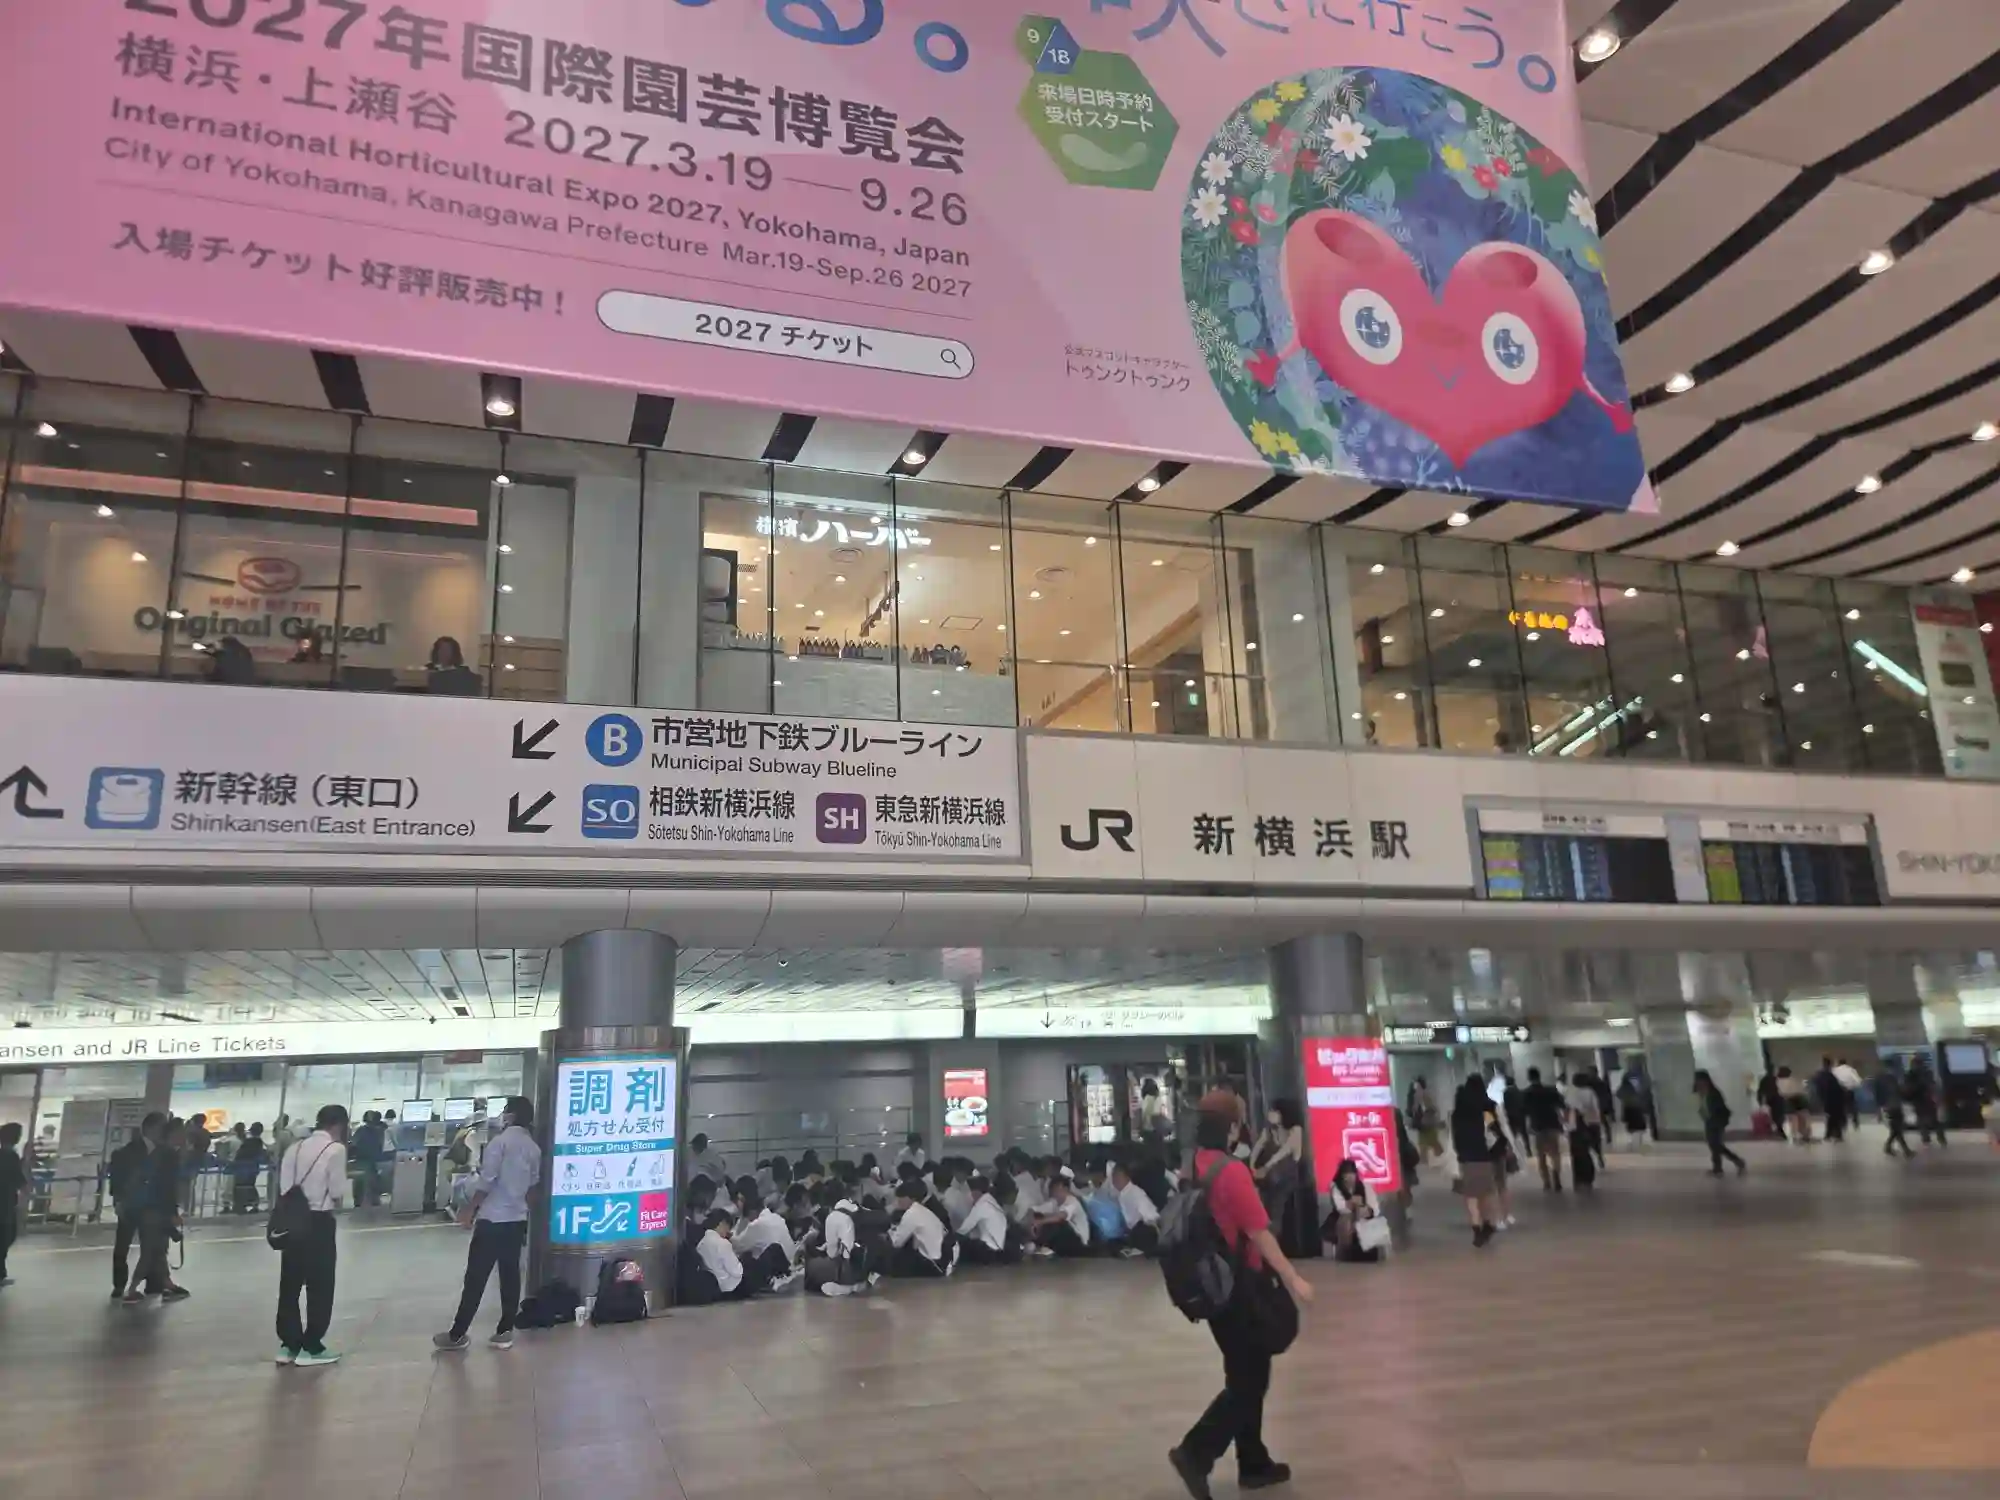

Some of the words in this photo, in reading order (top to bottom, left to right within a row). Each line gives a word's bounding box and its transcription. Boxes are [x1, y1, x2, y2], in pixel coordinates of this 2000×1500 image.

[115, 31, 457, 135] 横浜・上瀬谷
[1037, 81, 1153, 114] 来場日時予約
[1045, 105, 1154, 134] 受付スタート
[111, 97, 340, 159] International
[349, 139, 554, 197] Horticultural
[564, 179, 639, 214] Expo
[648, 194, 730, 231] 2027,
[739, 210, 887, 257] Yokohama,
[894, 234, 971, 270] Japan
[104, 137, 173, 172] City
[182, 149, 217, 173] of
[225, 158, 398, 209] Yokohama,
[407, 186, 559, 233] Kanagawa
[567, 214, 709, 257] Prefecture
[722, 240, 905, 289] Mar.19-Sep.26
[911, 272, 972, 299] 2027
[696, 312, 772, 344] 2027
[780, 324, 873, 359] チケット
[603, 724, 629, 756] B
[650, 716, 983, 758] 市営地下鉄ブルーライン
[651, 752, 744, 774] Municipal
[747, 756, 822, 778] Subway
[827, 760, 897, 779] Blueline
[585, 798, 636, 825] SO
[649, 786, 797, 820] 相鉄新横浜線
[874, 793, 1007, 825] 東急新横浜線
[372, 817, 476, 838] Entrance)
[690, 824, 769, 844] Shin-Yokohama
[772, 828, 795, 844] Line
[823, 807, 860, 831] SH
[1060, 808, 1136, 853] JR
[1193, 811, 1412, 861] 新横浜駅
[907, 831, 980, 849] Shin-Yokohama
[982, 834, 1002, 849] Line
[74, 1040, 112, 1056] and
[122, 1038, 148, 1055] JR
[158, 1039, 201, 1055] Line
[211, 1035, 287, 1053] Tickets
[568, 1066, 667, 1117] 調剤
[567, 1116, 665, 1138] 処方せん受付
[575, 1143, 604, 1155] Super
[606, 1142, 630, 1154] Drug
[632, 1140, 656, 1151] Store
[556, 1205, 592, 1236] 1F
[639, 1219, 668, 1232] Express
